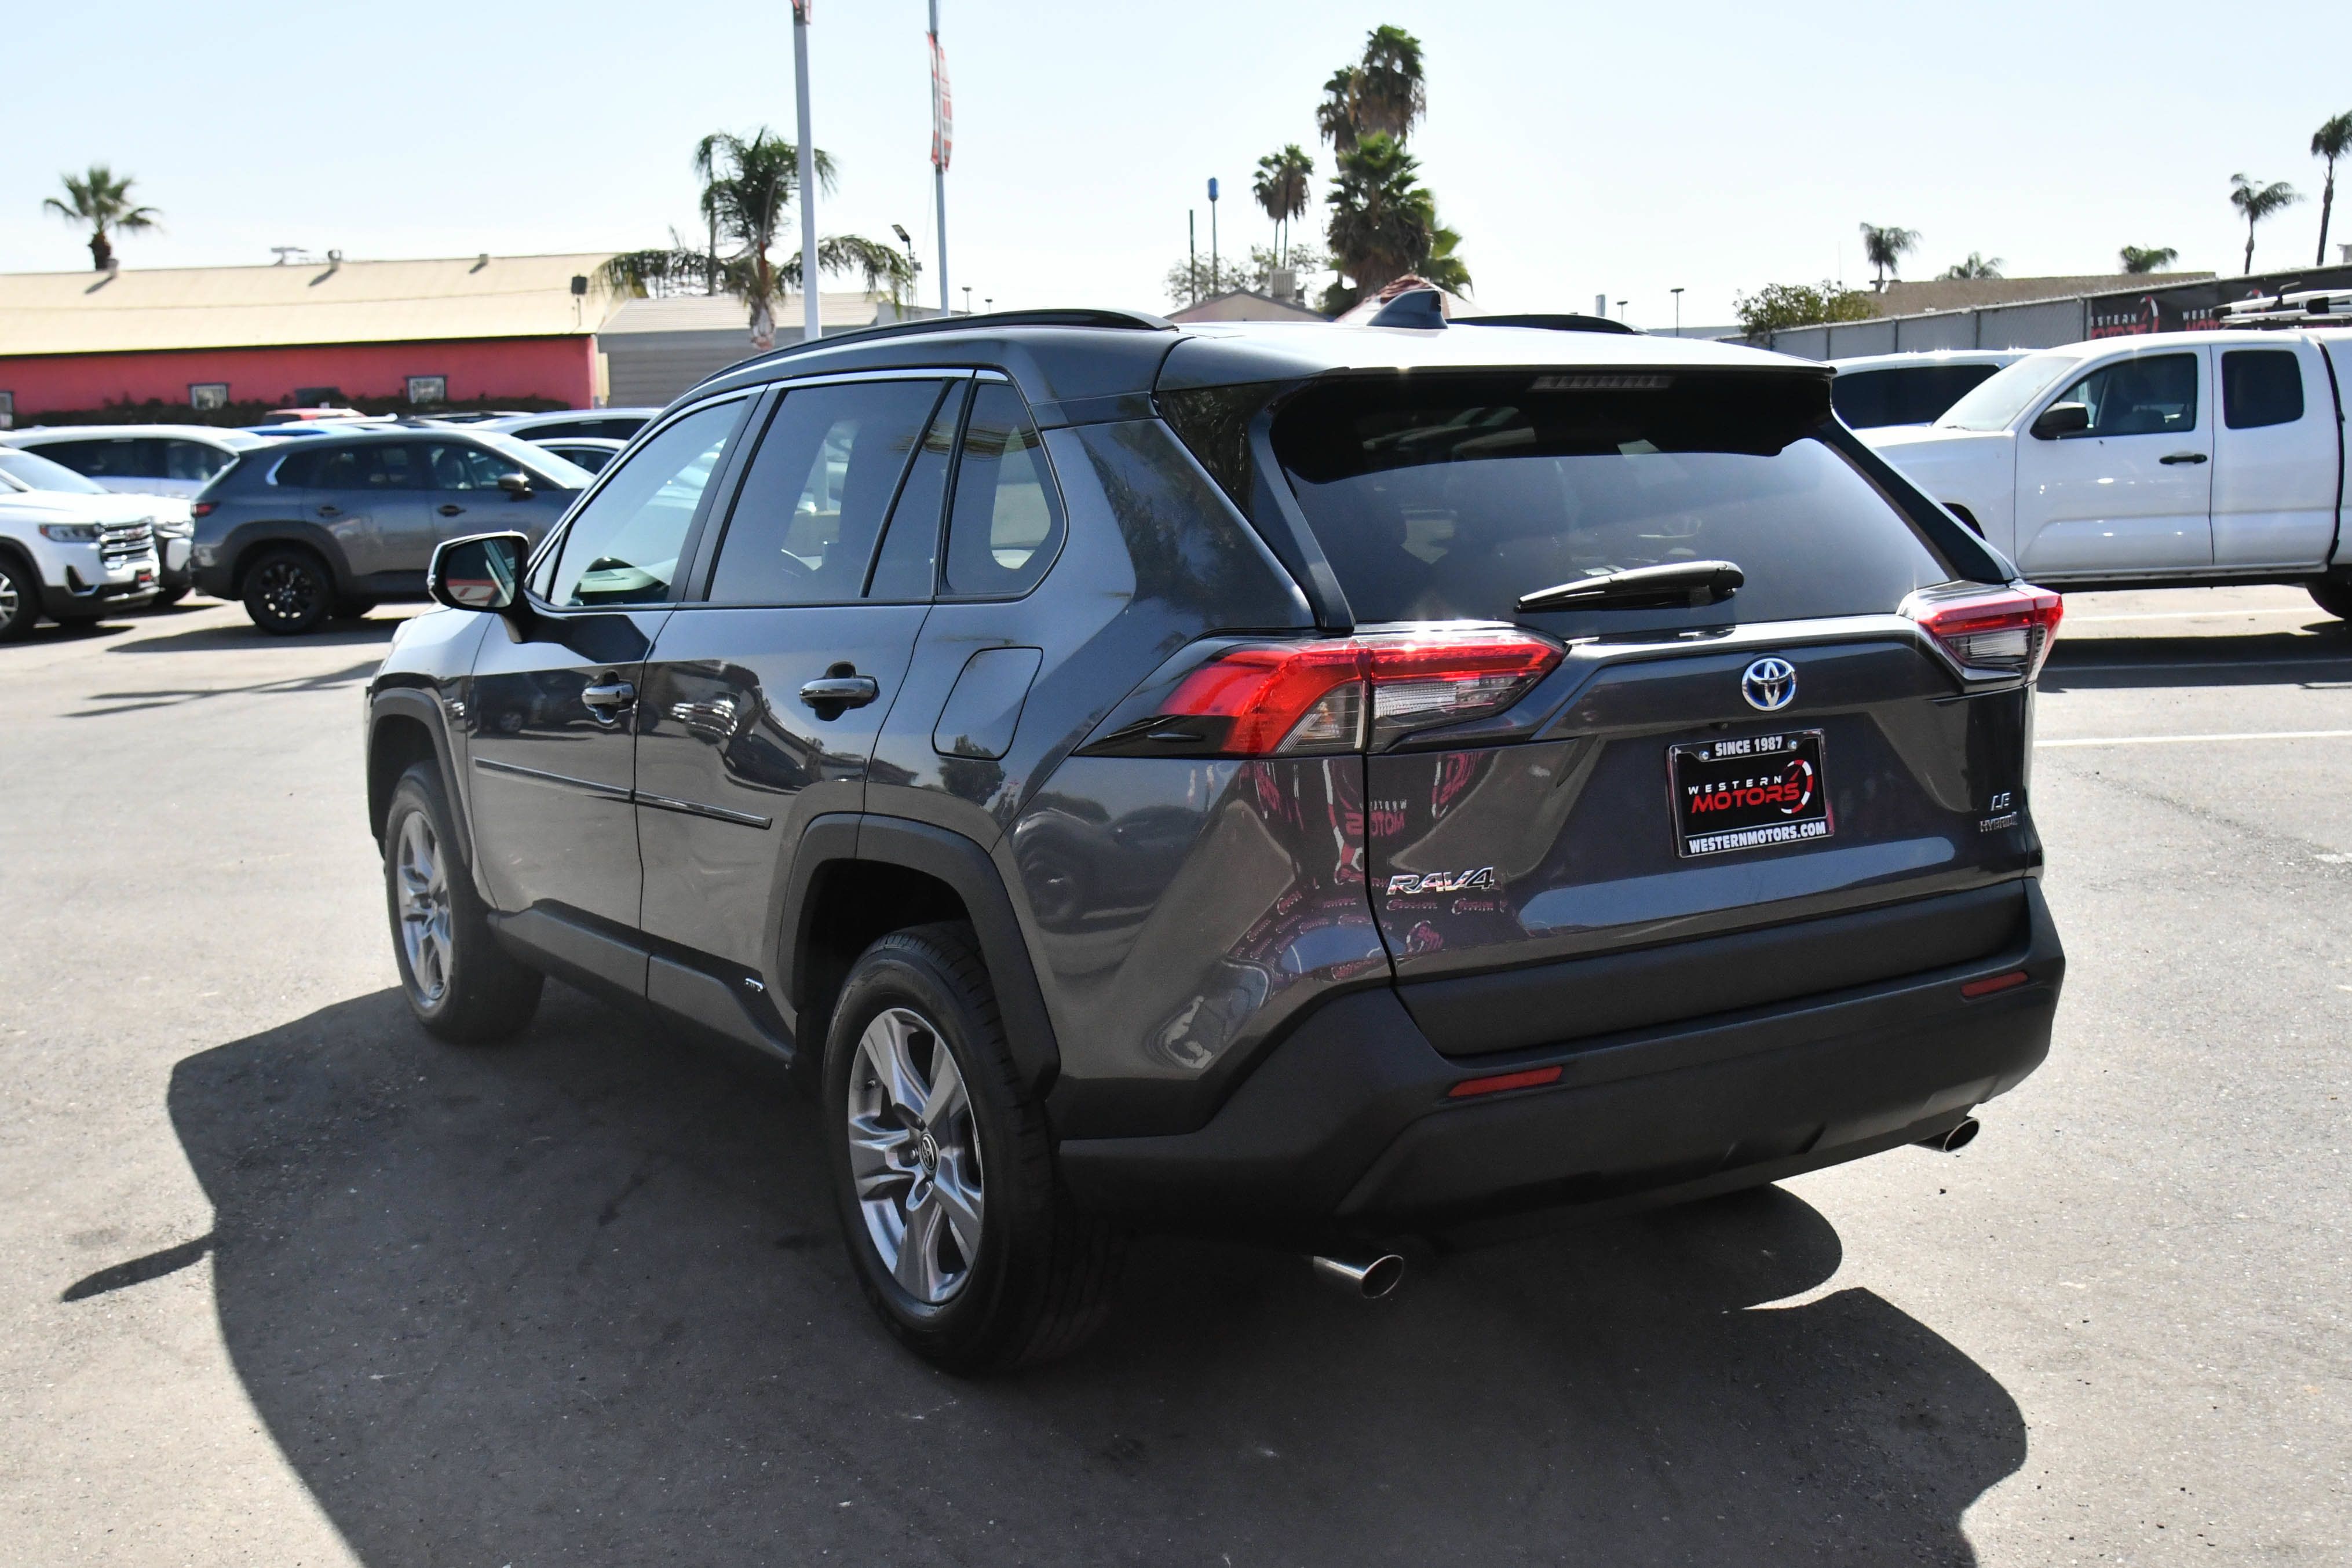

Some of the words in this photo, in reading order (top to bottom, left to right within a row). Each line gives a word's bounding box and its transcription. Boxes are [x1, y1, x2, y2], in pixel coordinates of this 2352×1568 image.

[1715, 739, 1751, 756] SINCE
[1754, 736, 1783, 751] 1987
[1688, 775, 1782, 795] WESTERN
[1692, 782, 1800, 813] MOTORS
[1689, 821, 1826, 854] WESTERNMOTORS.COM
[1386, 867, 1495, 896] RAV4
